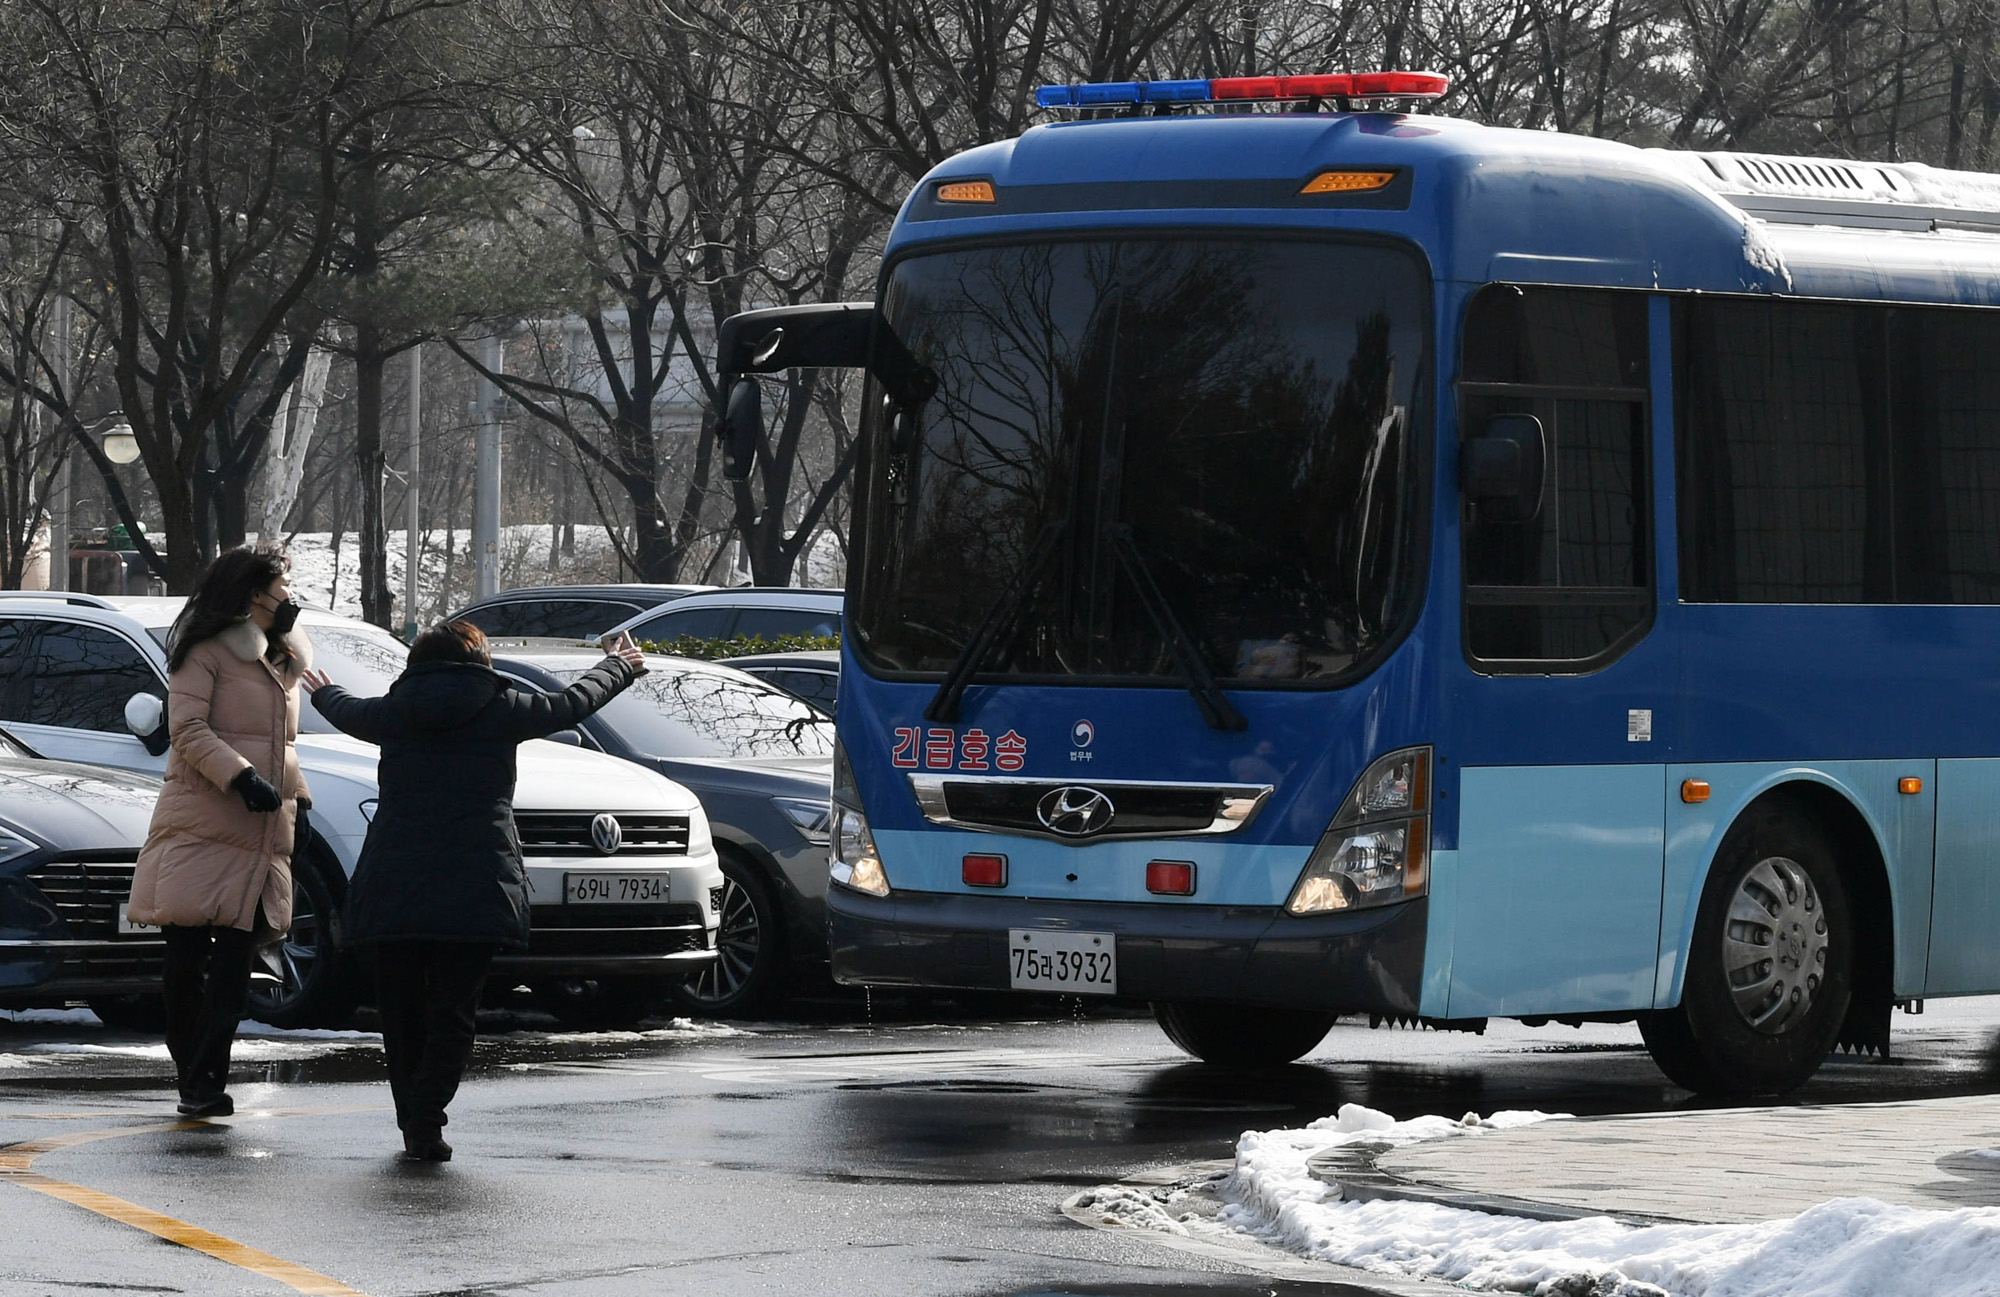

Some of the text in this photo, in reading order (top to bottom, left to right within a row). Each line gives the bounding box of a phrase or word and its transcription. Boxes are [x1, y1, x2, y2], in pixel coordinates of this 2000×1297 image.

[892, 726, 1027, 771] 긴급호송
[1069, 751, 1093, 762] 법무부
[577, 879, 660, 899] 69나 7934
[1012, 948, 1112, 984] 75라3932
